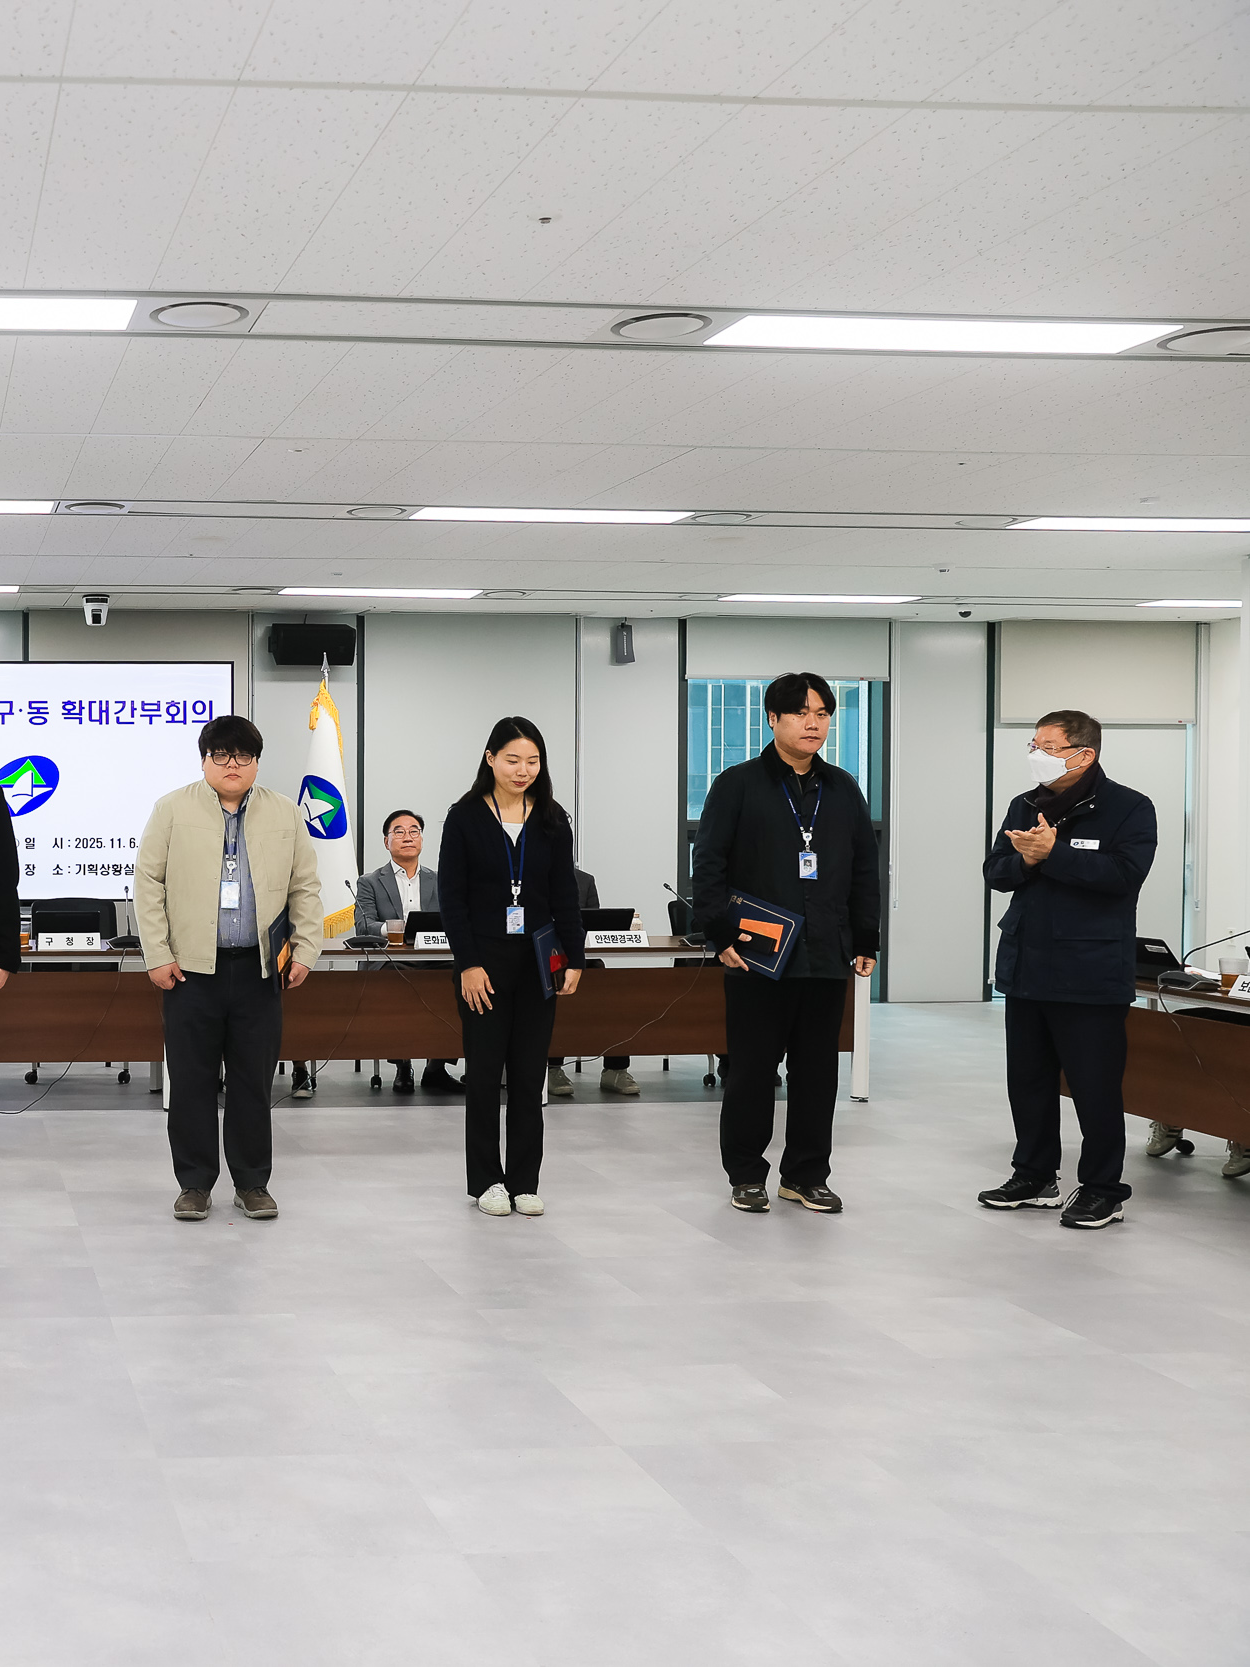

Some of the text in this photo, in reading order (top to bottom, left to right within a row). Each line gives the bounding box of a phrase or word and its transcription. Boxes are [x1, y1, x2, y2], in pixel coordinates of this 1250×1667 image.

[61, 700, 214, 726] 확대간부회의
[24, 837, 36, 850] 일
[52, 837, 63, 850] 시
[74, 837, 106, 849] 2025.
[24, 863, 36, 876] 장
[52, 864, 63, 876] 소
[75, 863, 135, 876] 기획상황실
[423, 935, 448, 945] 문화교
[594, 934, 642, 944] 안전환경국장
[1238, 980, 1250, 993] 보
